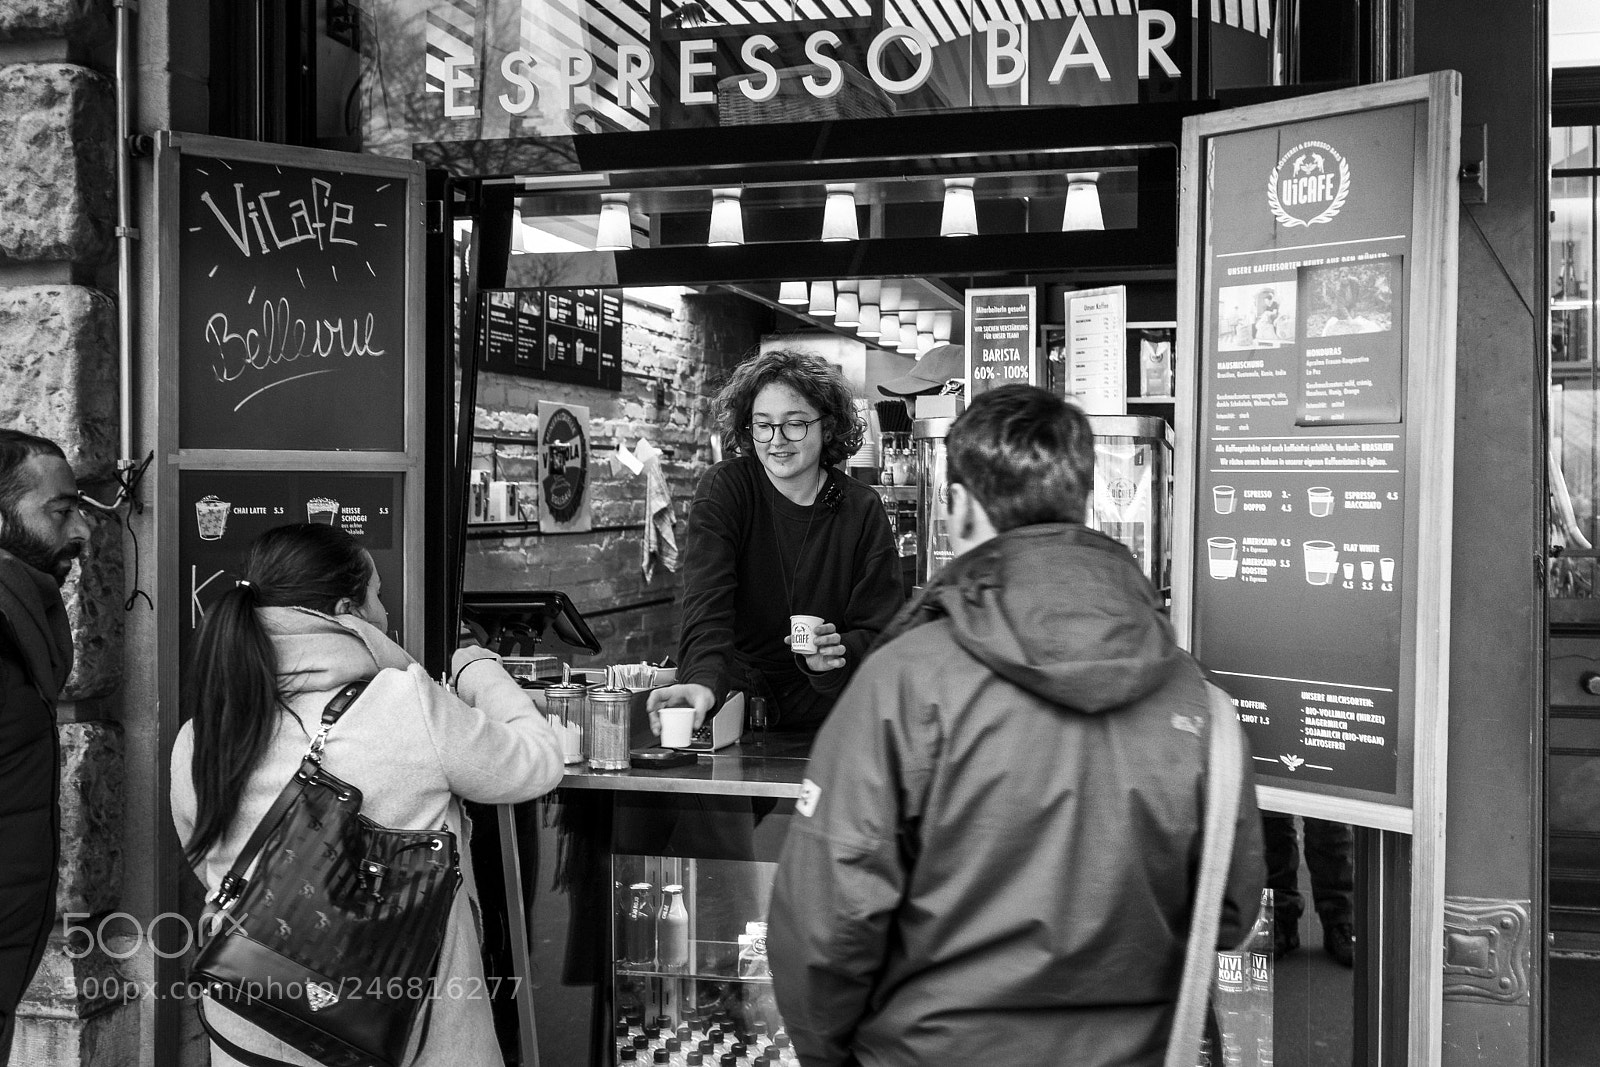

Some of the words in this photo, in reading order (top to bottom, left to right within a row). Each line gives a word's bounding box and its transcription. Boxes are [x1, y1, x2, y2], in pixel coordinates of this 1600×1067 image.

[443, 26, 935, 119] ESPRESSO
[986, 10, 1183, 86] BAR
[1227, 266, 1252, 276] UNSERE
[1253, 261, 1301, 274] KAFFEESORTEN
[982, 348, 1021, 362] BARISTA
[1306, 347, 1342, 357] HONDURAS
[974, 366, 995, 380] 60%
[1003, 365, 1029, 379] 100%
[1243, 489, 1273, 499] ESPRESSO
[1344, 491, 1377, 500] ESPRESSO
[1386, 491, 1399, 501] 4.5
[233, 506, 249, 515] CHAI
[249, 506, 267, 515] LATTE
[1243, 503, 1267, 512] DOPPIO
[1281, 503, 1293, 513] 4.5
[1344, 500, 1383, 510] MACCHIATO
[341, 507, 361, 515] HEISSE
[341, 514, 368, 523] SCHOGGI
[1242, 537, 1278, 547] AMERICANO
[1343, 543, 1359, 552] FLAT
[1359, 544, 1381, 553] WHITE
[1241, 557, 1277, 568] AMERICANO
[1241, 566, 1268, 576] BOOSTER
[1240, 699, 1268, 711] KOFFEIN:
[1301, 691, 1326, 702] UNSERE
[1326, 694, 1375, 708] MILCHSORTEN:
[1241, 713, 1258, 724] SHOT
[1305, 717, 1348, 731] MAGERMILCH
[1305, 727, 1341, 740] SOJAMILCH
[1304, 737, 1346, 751] LAKTOSEFREI
[1218, 955, 1242, 970] VIVI
[1218, 967, 1243, 981] KOLA
